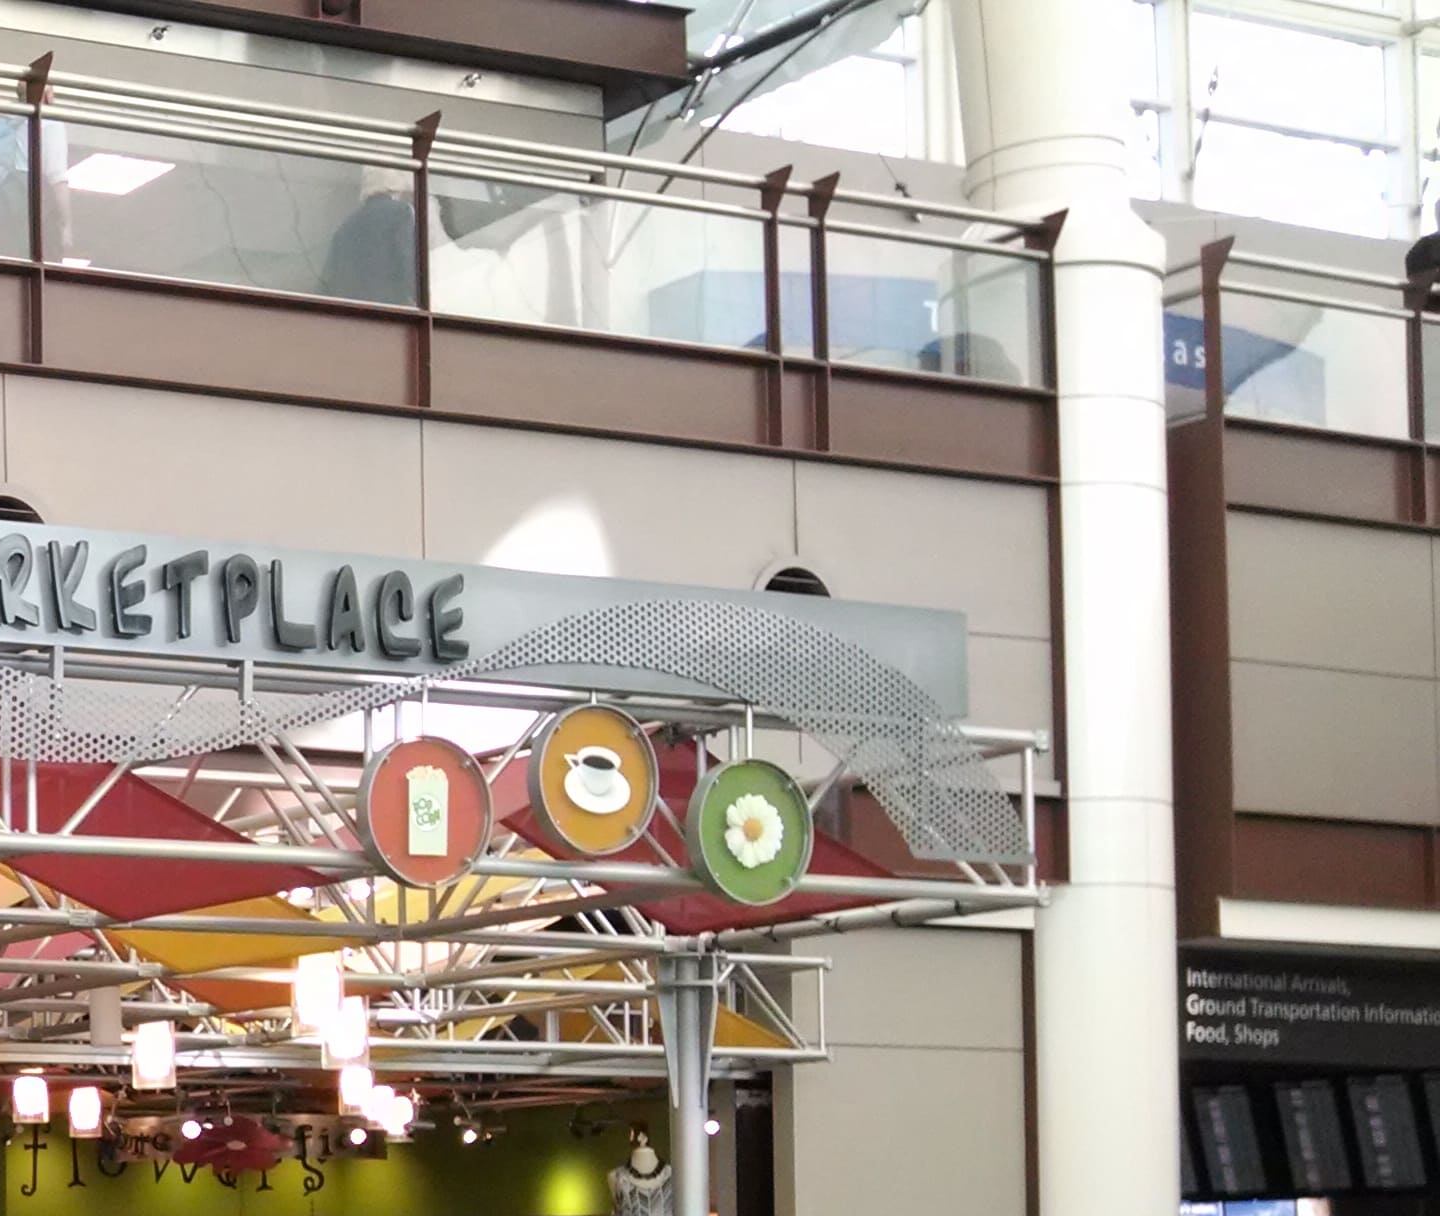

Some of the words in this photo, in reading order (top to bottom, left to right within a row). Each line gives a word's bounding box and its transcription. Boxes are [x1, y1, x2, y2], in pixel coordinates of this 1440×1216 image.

[1186, 967, 1287, 992] International
[1291, 975, 1352, 996] Arrivals,
[1186, 993, 1246, 1017] Ground
[1251, 999, 1361, 1024] Transportation
[1186, 1021, 1229, 1046] Food,
[1233, 1024, 1280, 1048] Shops
